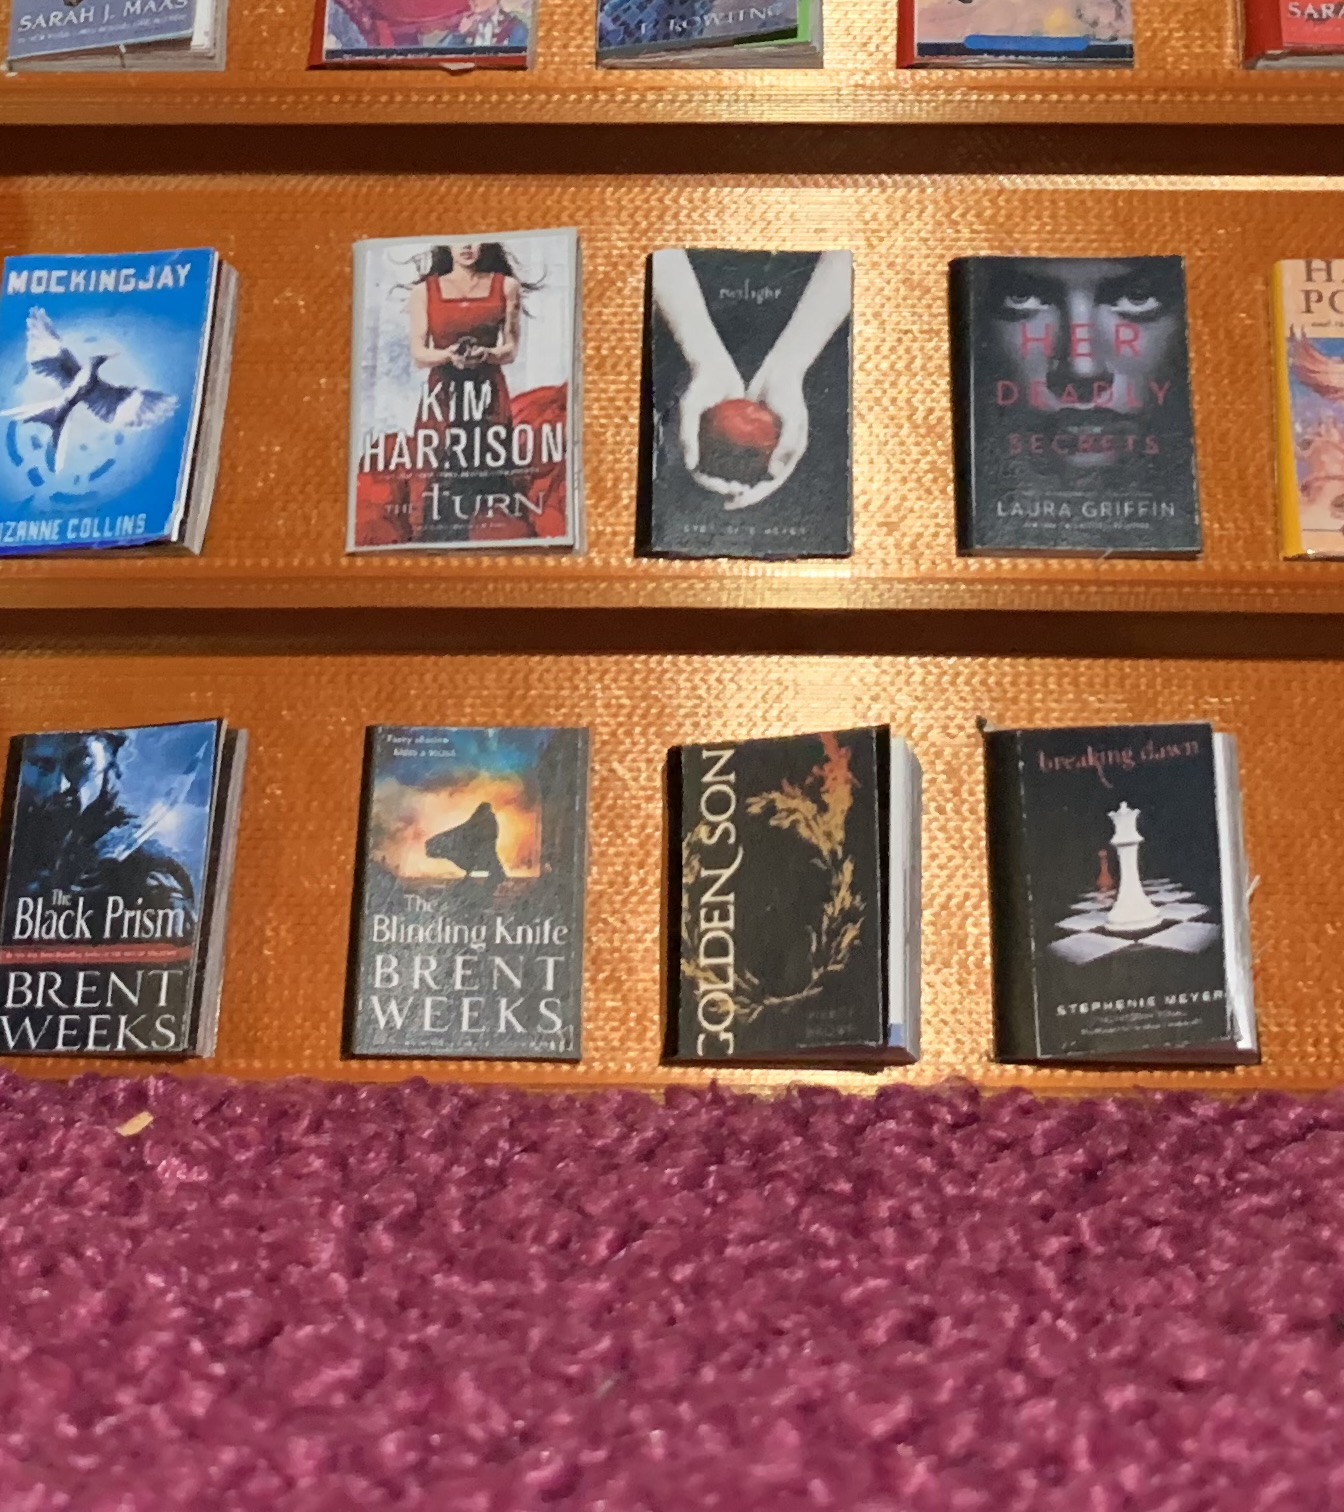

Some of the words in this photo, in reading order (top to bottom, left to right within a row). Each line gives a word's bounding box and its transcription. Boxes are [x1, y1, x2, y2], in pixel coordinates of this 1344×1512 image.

[18, 6, 95, 33] SARAH
[7, 263, 192, 295] MOCKINGJAY
[1019, 323, 1142, 359] HER
[422, 379, 492, 423] KIM
[996, 380, 1171, 408] DEADLY
[362, 422, 564, 473] HARRISON
[1009, 434, 1160, 456] SECRETS
[422, 483, 545, 521] TURN
[996, 501, 1071, 517] LAURA
[1081, 501, 1175, 518] GRIFFIN
[67, 513, 146, 539] COLLINS
[1038, 745, 1136, 788] breaking
[1140, 739, 1199, 760] dawn
[699, 748, 737, 845] SON
[52, 888, 72, 906] The
[404, 893, 437, 912] The
[13, 896, 94, 940] Black
[103, 895, 185, 939] Prism
[372, 914, 487, 951] Blinding
[494, 916, 569, 945] Knife
[5, 969, 184, 1009] BRENT
[373, 954, 566, 992] BRENT
[370, 994, 564, 1034] WEEKS
[1056, 996, 1156, 1016] STEPHENIE
[1164, 990, 1223, 1005] MEYER
[0, 1014, 176, 1051] WEEKS
